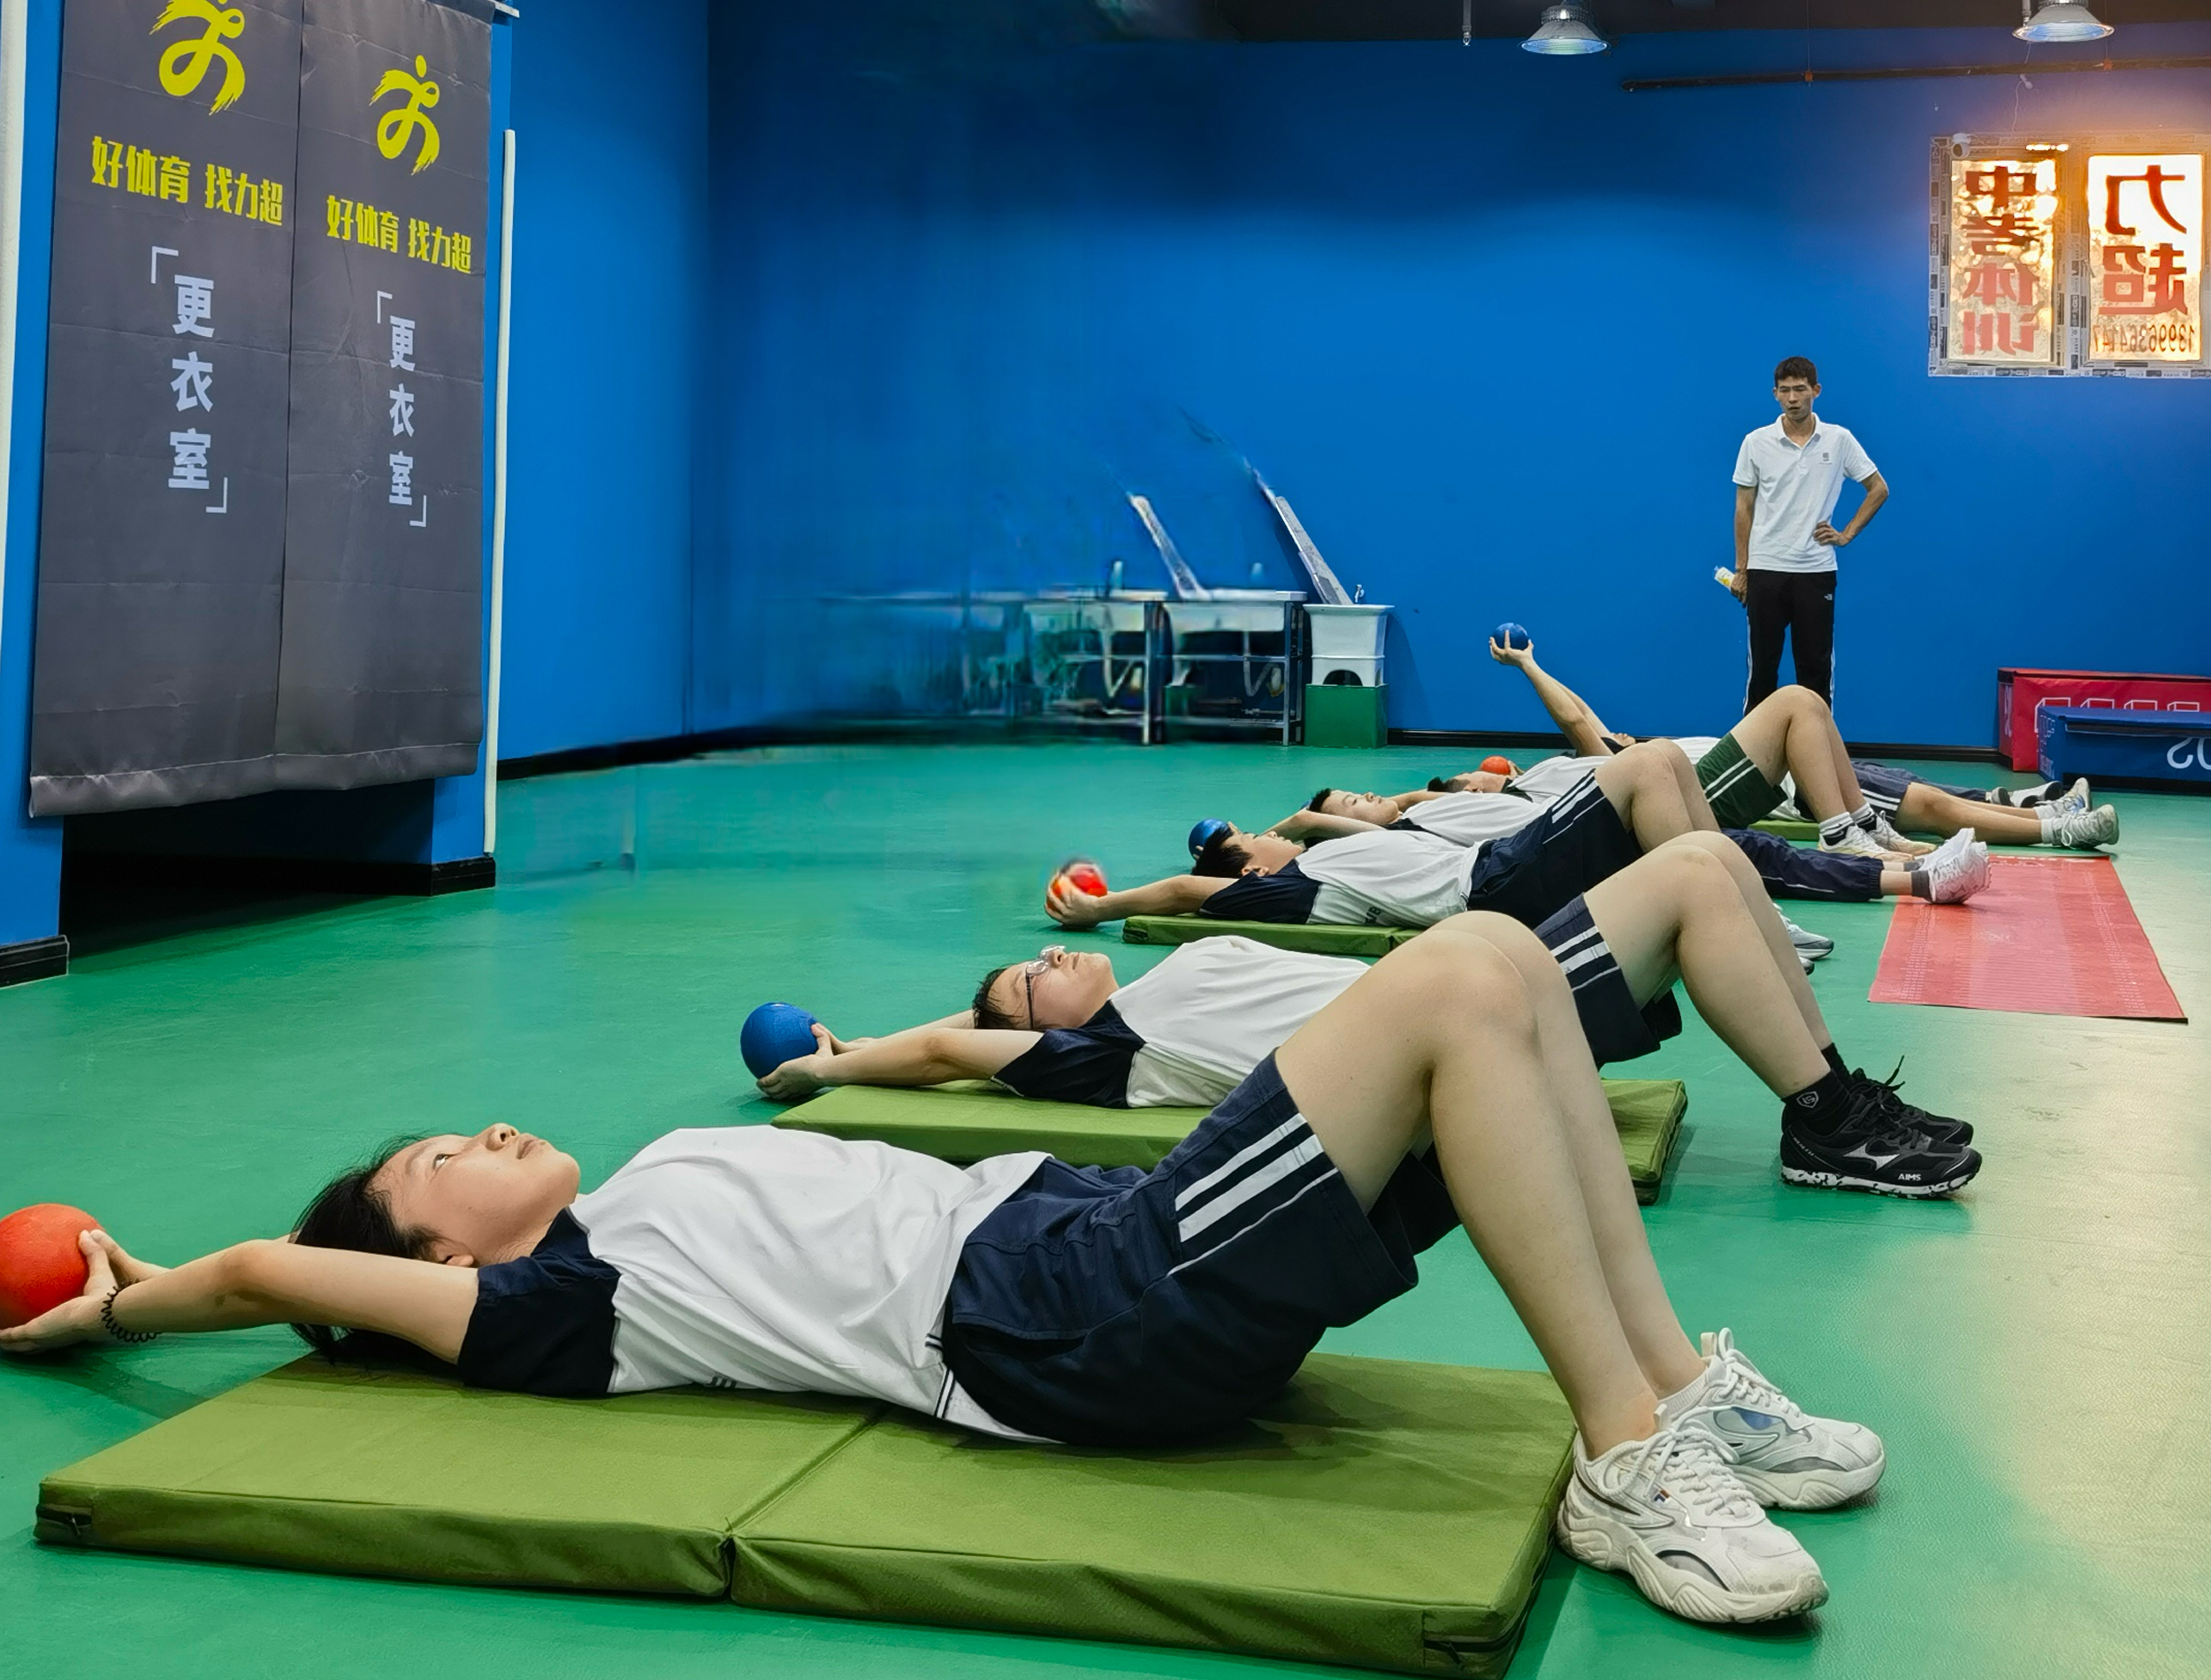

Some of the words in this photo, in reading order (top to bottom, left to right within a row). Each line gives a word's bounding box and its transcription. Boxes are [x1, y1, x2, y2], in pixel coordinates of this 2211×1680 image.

[91, 135, 190, 204] 好体育
[204, 164, 283, 226] 找力超
[326, 195, 401, 254] 好体育
[408, 218, 472, 274] 找力超
